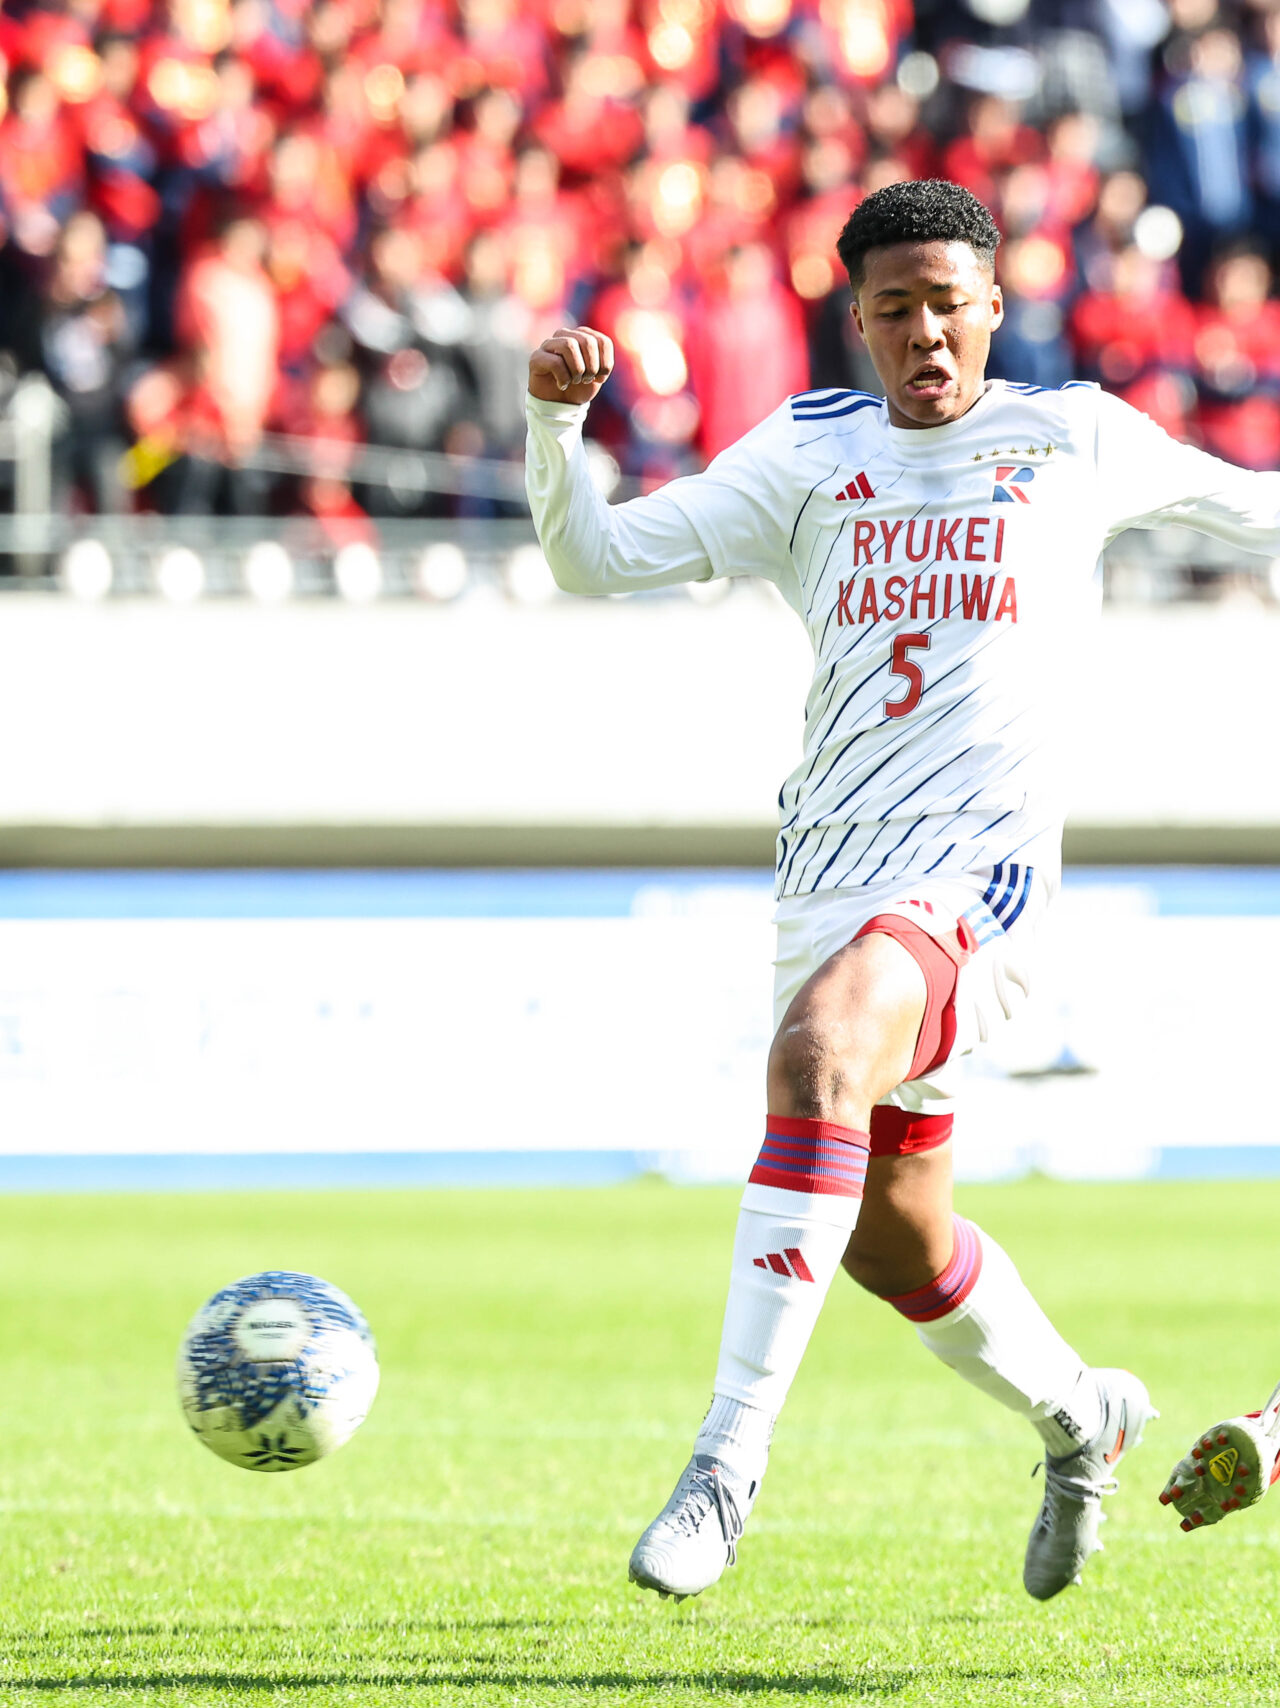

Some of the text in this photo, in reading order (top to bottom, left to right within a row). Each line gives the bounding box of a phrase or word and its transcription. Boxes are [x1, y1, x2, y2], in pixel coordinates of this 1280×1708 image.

[853, 517, 1005, 566] RYUKEI
[837, 574, 1017, 626] KASHIWA
[883, 632, 931, 720] 5
